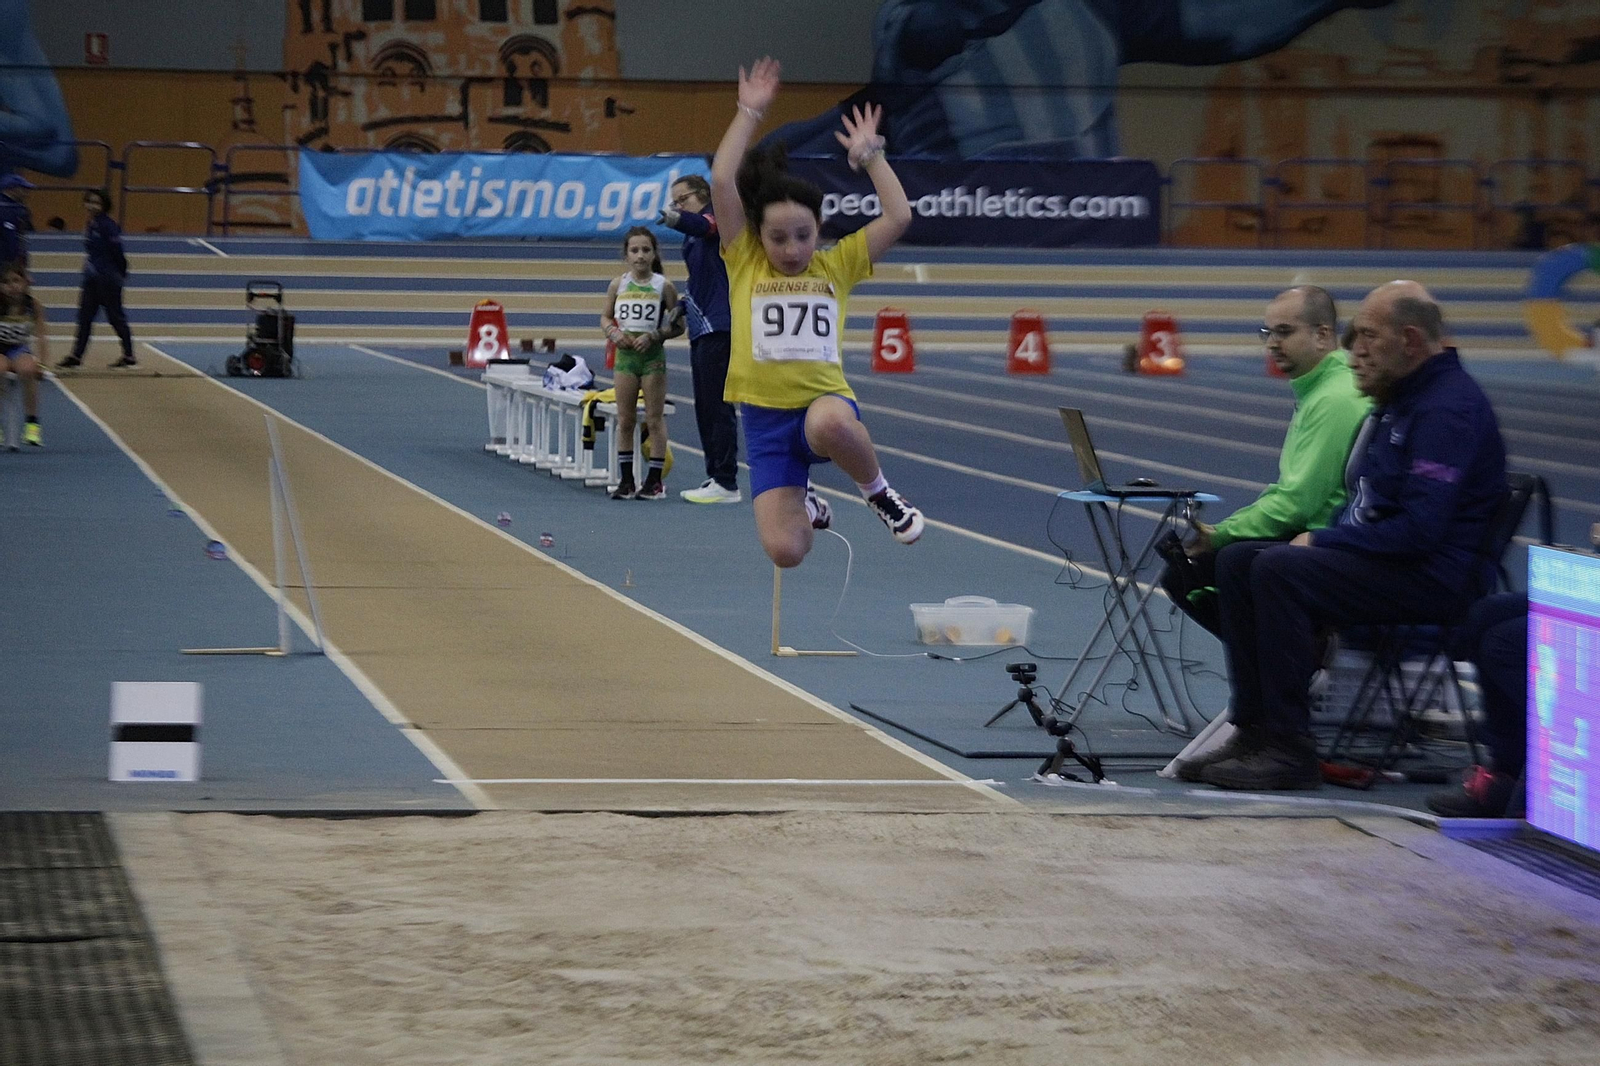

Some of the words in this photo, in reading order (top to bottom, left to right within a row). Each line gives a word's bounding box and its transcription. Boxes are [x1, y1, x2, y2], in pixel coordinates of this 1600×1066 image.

[821, 185, 1147, 222] pea-athletics.com
[620, 303, 655, 321] 892
[762, 302, 830, 337] 976
[478, 324, 499, 361] 8
[879, 328, 903, 361] 5
[1014, 331, 1043, 363] 4
[1150, 330, 1174, 362] 3
